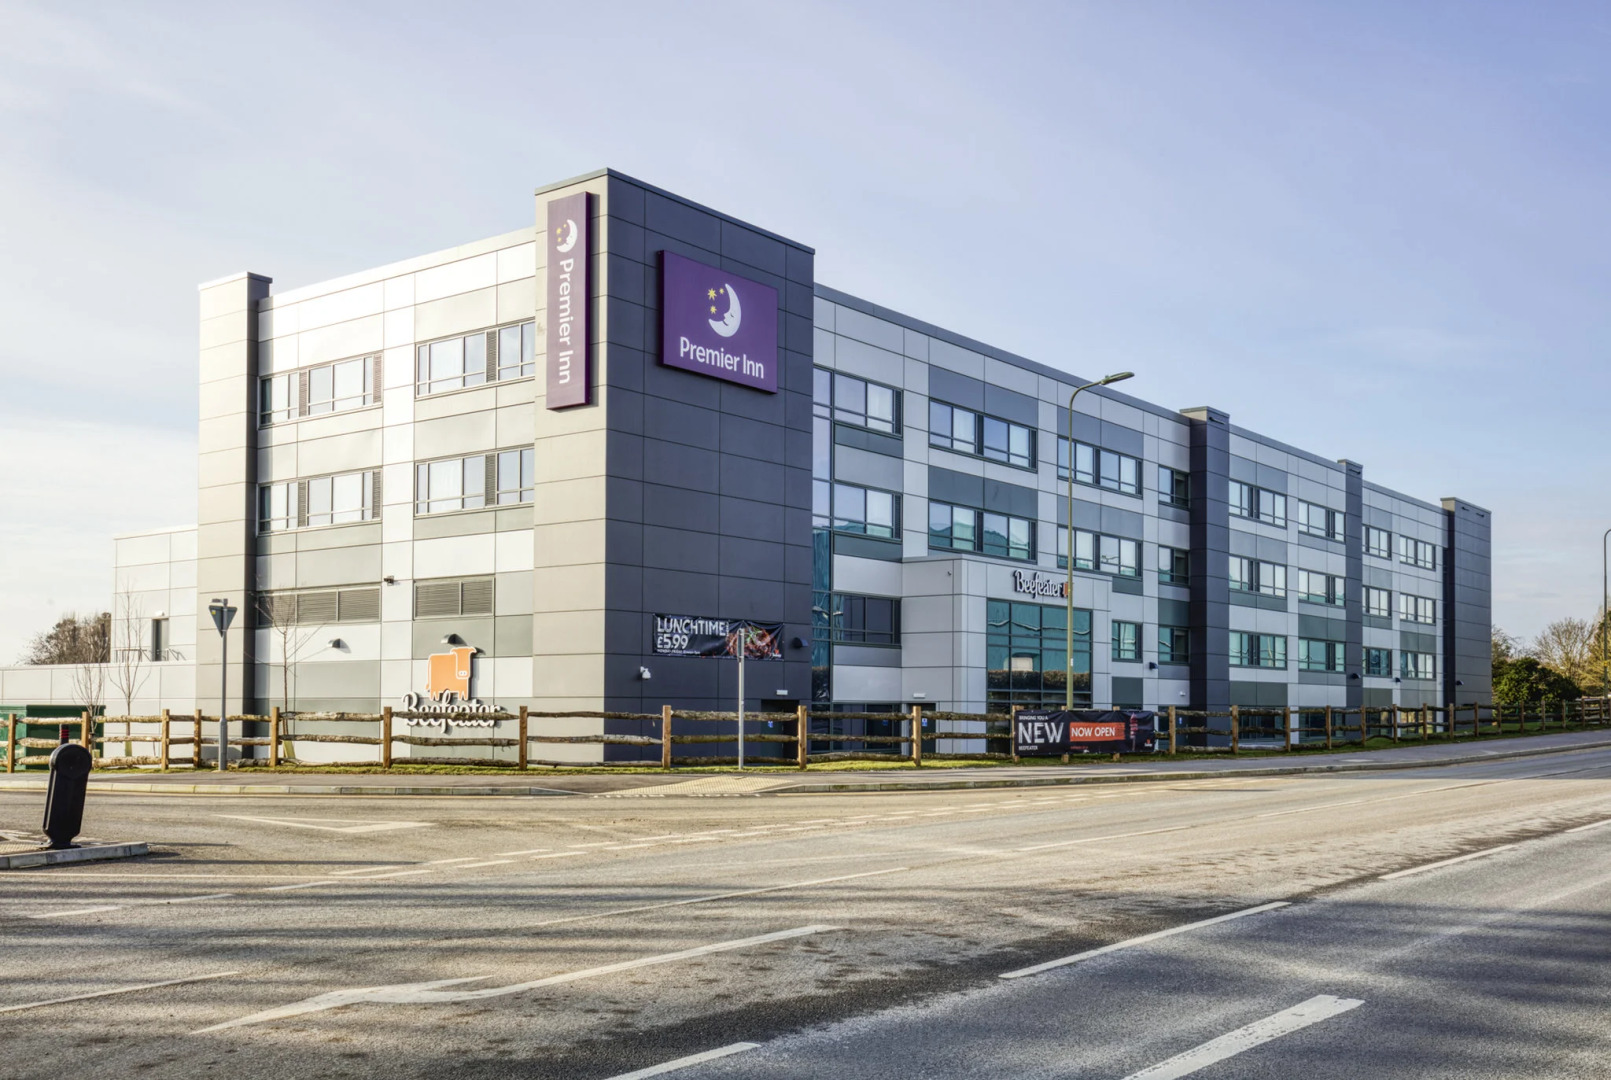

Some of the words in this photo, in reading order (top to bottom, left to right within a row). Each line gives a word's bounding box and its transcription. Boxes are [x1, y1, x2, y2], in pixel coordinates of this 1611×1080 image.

[559, 258, 573, 346] Premier
[559, 350, 573, 384] Inn
[680, 336, 740, 372] Premier
[743, 353, 764, 379] Inn
[1014, 569, 1062, 599] Beefeater
[657, 617, 726, 636] LUNCHTIME
[657, 633, 689, 650] £5.99
[1018, 722, 1064, 744] NEW
[1071, 727, 1093, 737] NOW
[1094, 727, 1115, 737] OPEN
